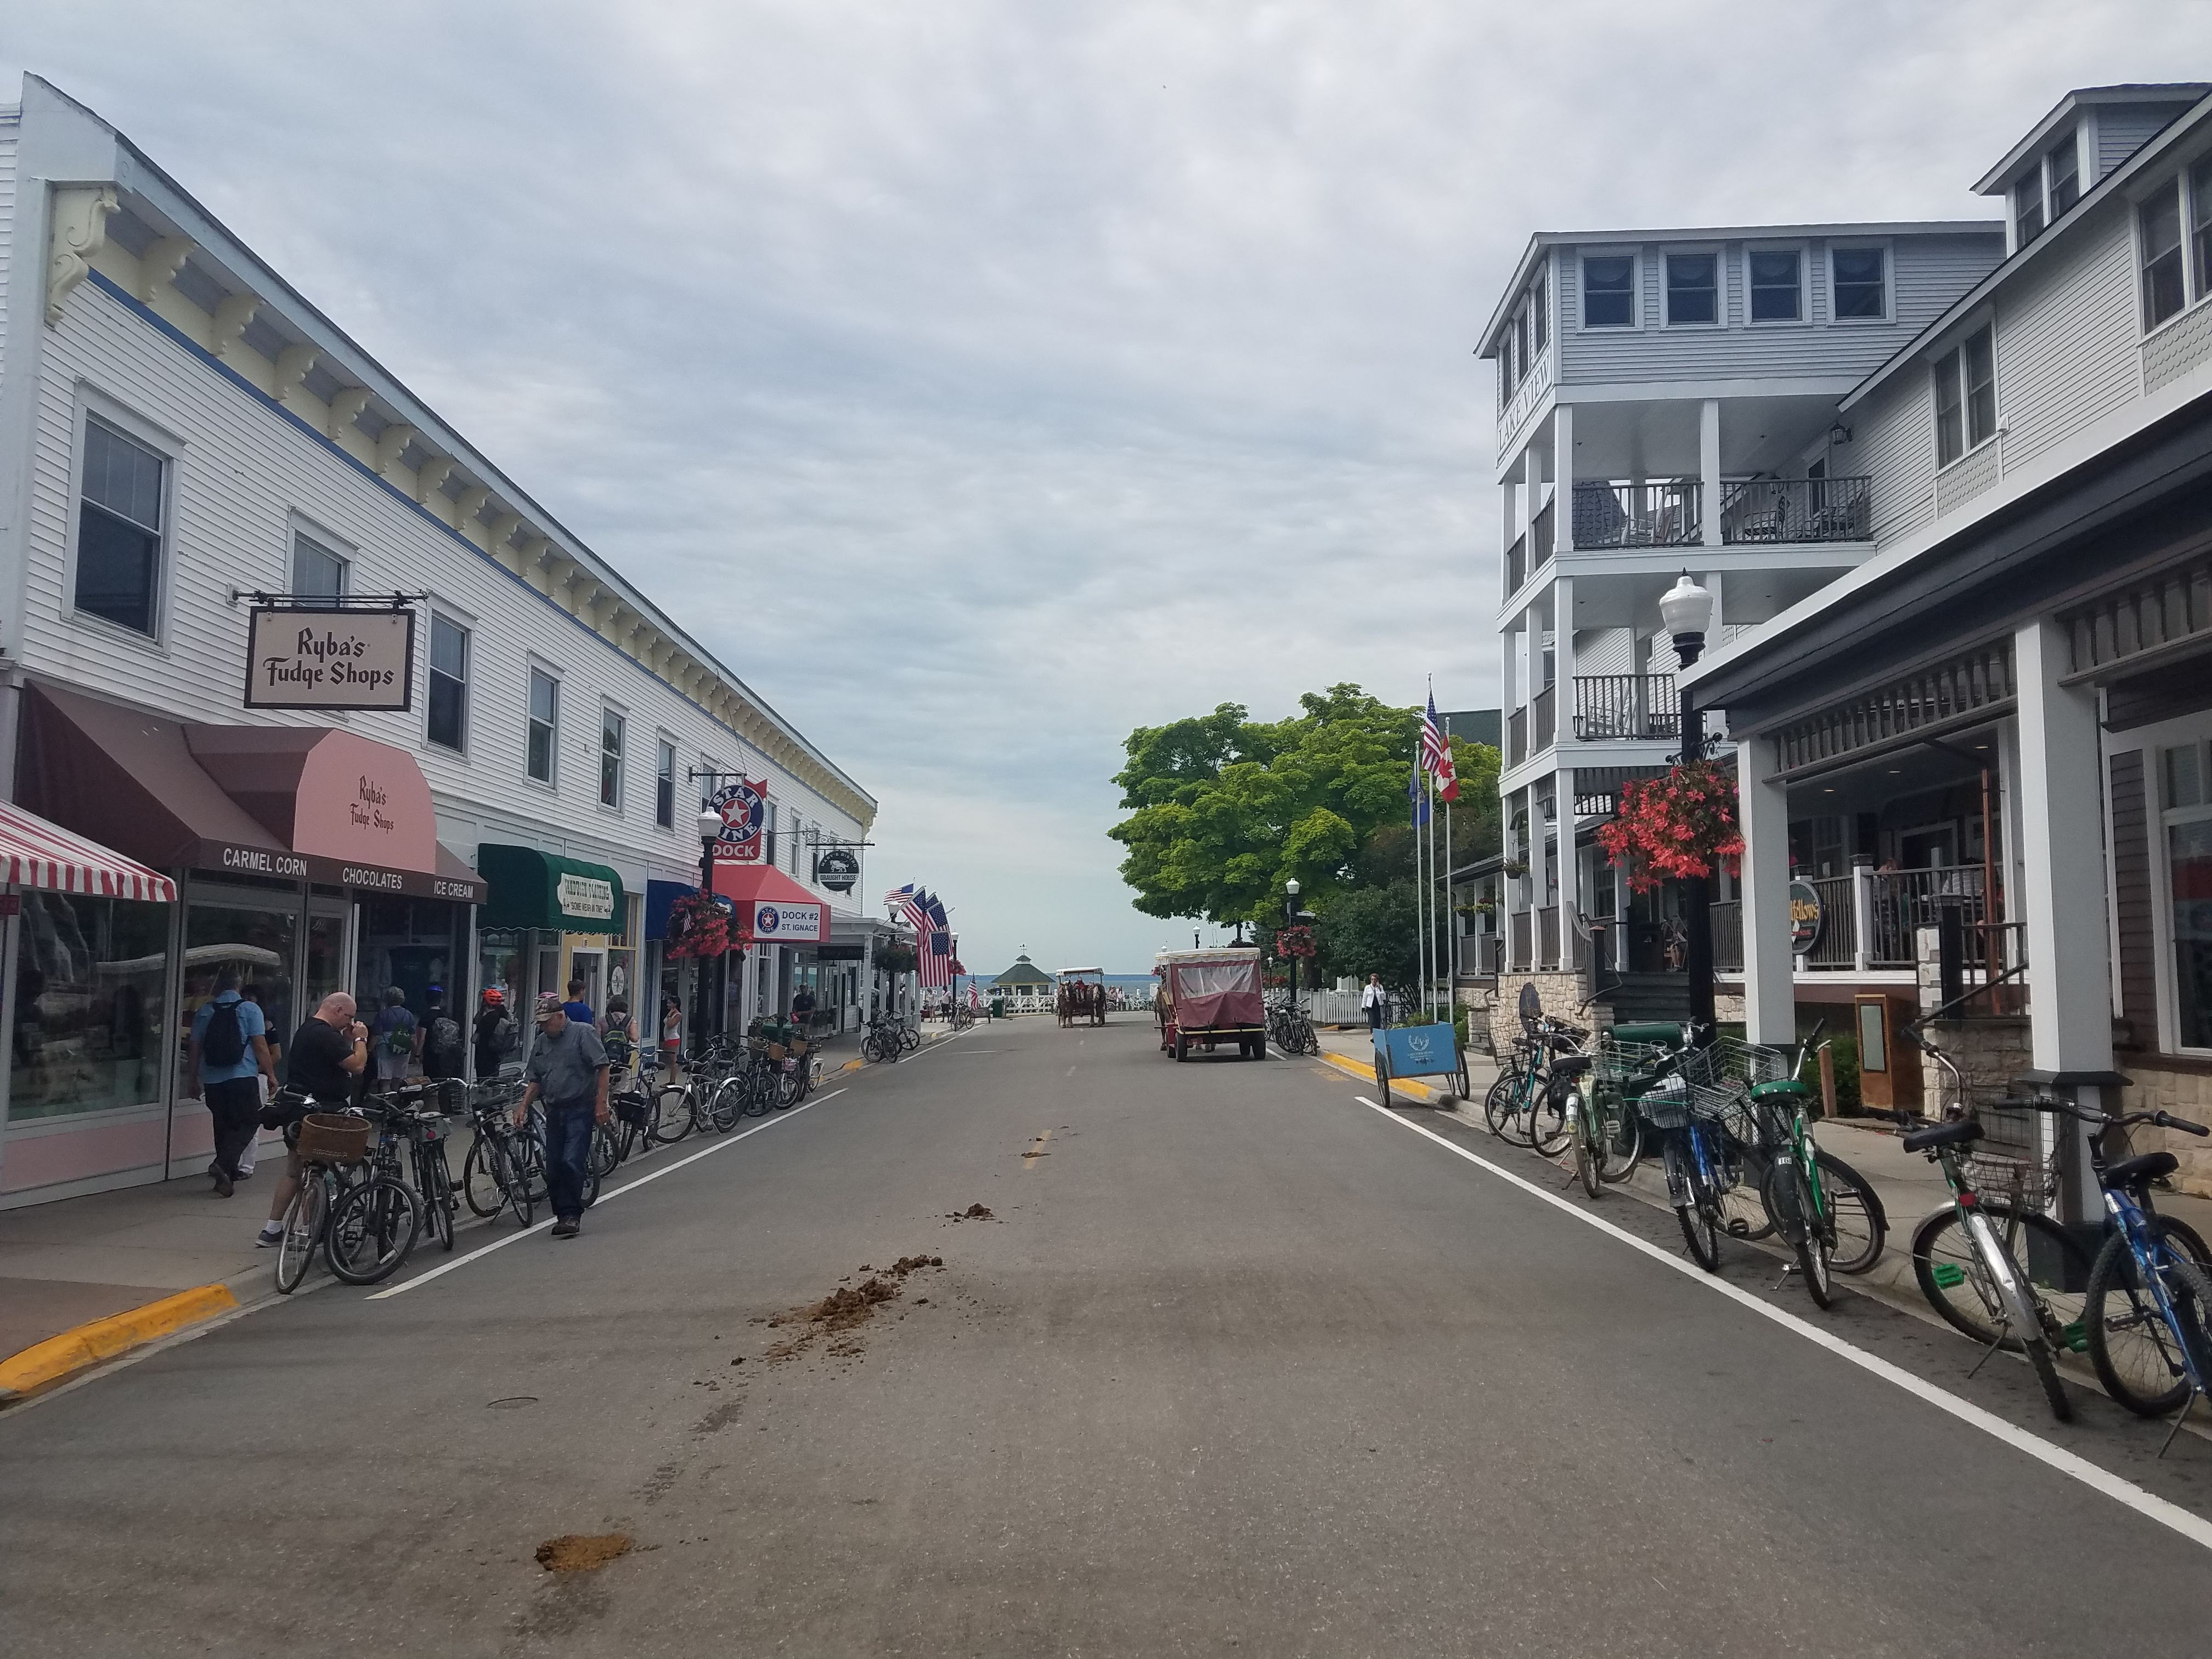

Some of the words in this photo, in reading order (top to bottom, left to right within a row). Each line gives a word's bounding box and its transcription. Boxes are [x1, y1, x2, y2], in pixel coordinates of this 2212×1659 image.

[1499, 399, 1522, 452] LAKE
[1523, 353, 1550, 412] VIEW
[297, 627, 366, 663] Ryba's
[263, 657, 324, 689] Fudge
[330, 661, 394, 690] Shops
[359, 775, 386, 809] Ryba's
[713, 787, 759, 808] STAR
[350, 803, 370, 830] Fudge
[374, 809, 394, 834] Shops
[720, 822, 758, 841] INE
[713, 844, 755, 857] DOCK
[223, 848, 273, 872] CARMEL
[276, 856, 307, 877] CORN
[342, 867, 403, 890] CHOCOLATES
[433, 881, 447, 896] ICE
[448, 882, 473, 899] CREAM
[782, 911, 807, 920] DOCK
